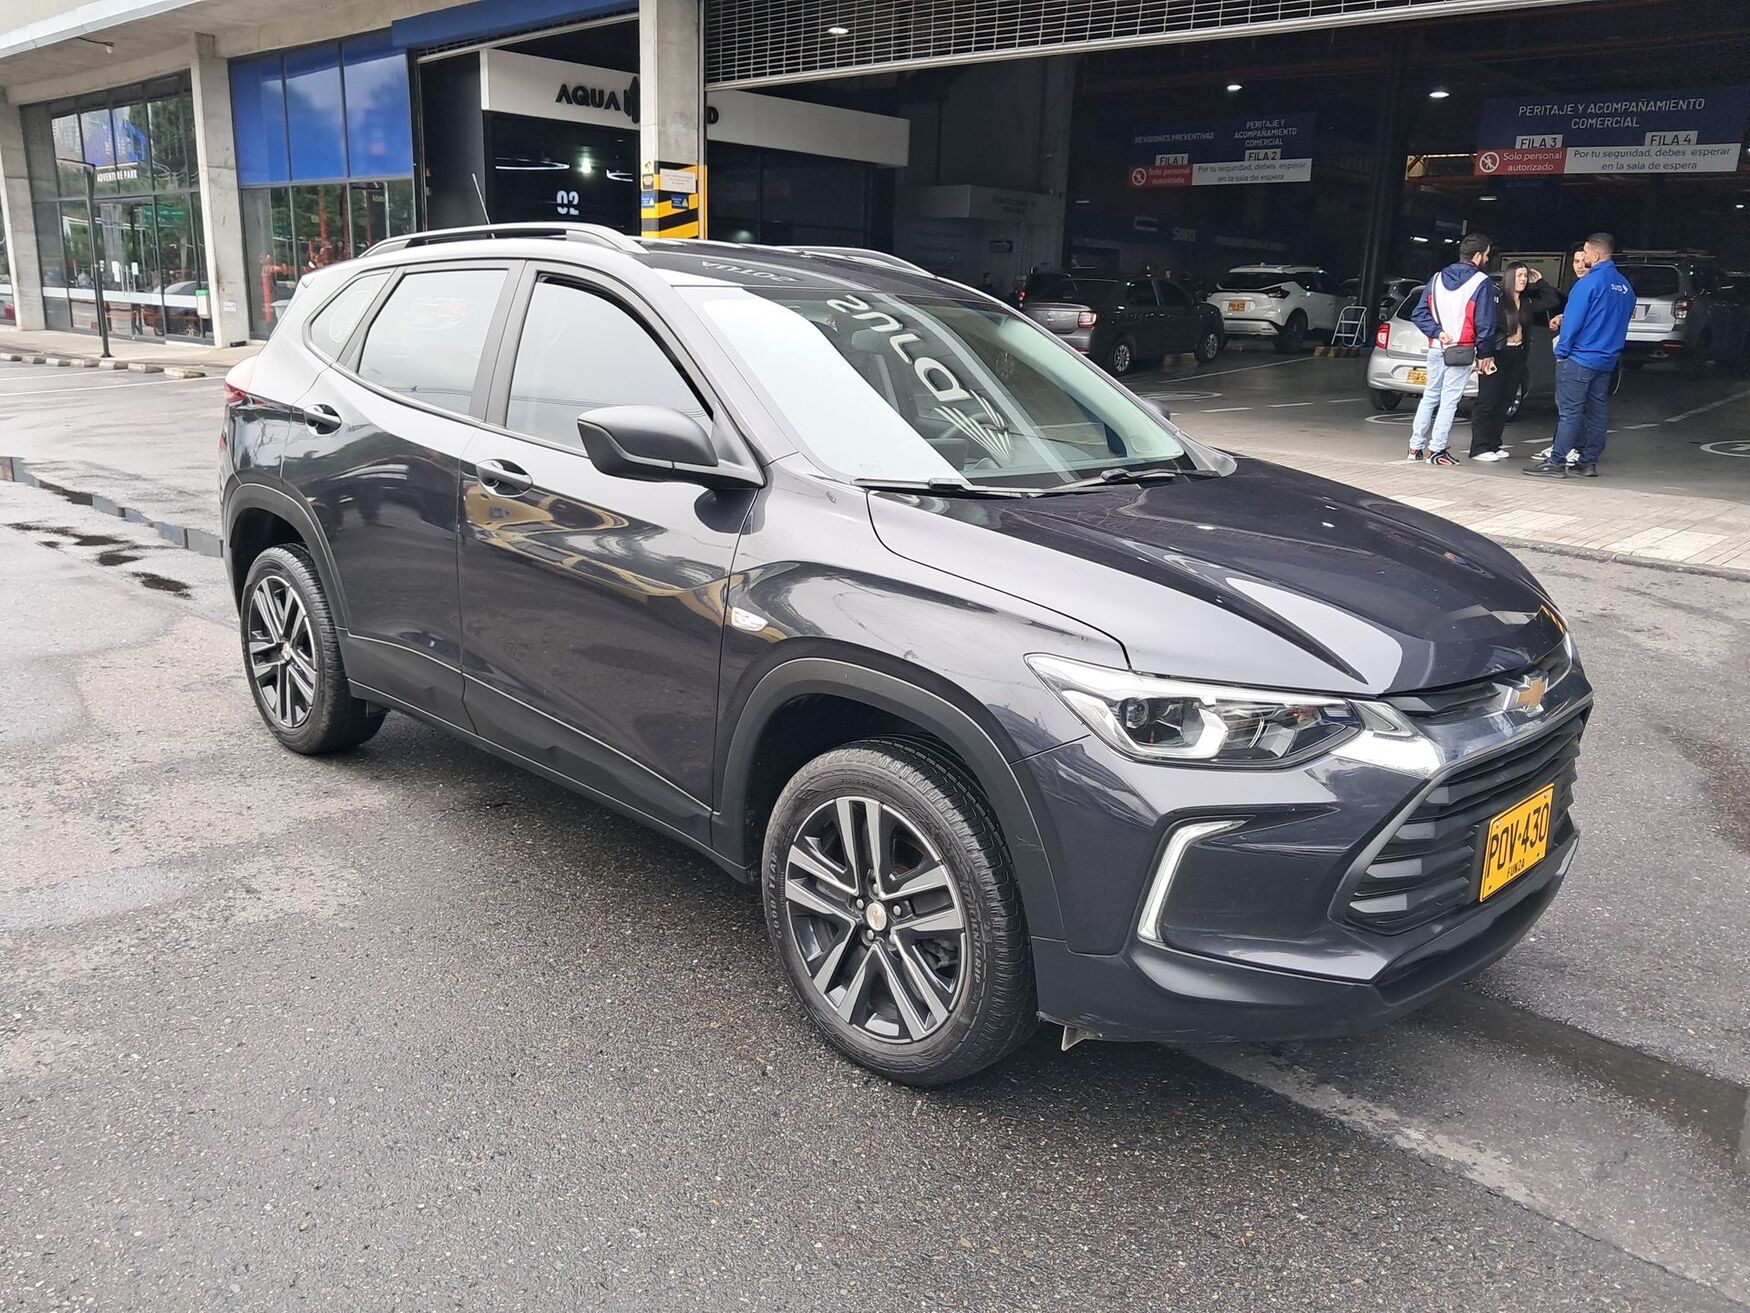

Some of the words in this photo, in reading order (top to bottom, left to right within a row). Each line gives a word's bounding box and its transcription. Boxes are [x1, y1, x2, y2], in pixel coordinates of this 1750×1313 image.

[556, 84, 621, 111] AQUA
[1519, 104, 1575, 116] PERITAJE
[1579, 104, 1585, 114] Y
[1588, 98, 1705, 114] ACOMPAÑAMIENTO
[1246, 120, 1279, 128] PERITAJE
[1572, 116, 1640, 128] COMERCIAL
[1234, 128, 1298, 139] ACOMPAÑAMIENTO
[1245, 139, 1284, 147] COMERCIAL
[1520, 138, 1546, 148] FILA
[1550, 138, 1558, 148] 3
[1650, 134, 1680, 146] FILA
[1684, 134, 1692, 145] 4
[1248, 152, 1270, 160] FILA
[1271, 152, 1277, 160] 2
[1504, 152, 1522, 160] Solo
[1523, 152, 1562, 162] personal
[1574, 150, 1588, 158] Por
[1591, 150, 1600, 158] tu
[1655, 148, 1686, 157] debes
[1691, 148, 1730, 157] esperar
[1160, 156, 1180, 166] FILA
[1602, 162, 1614, 170] en
[1616, 162, 1624, 170] la
[1626, 162, 1646, 170] sala
[1648, 161, 1661, 170] de
[1663, 162, 1697, 170] espera
[1508, 162, 1554, 172] autorizado
[124, 169, 138, 180] PARK
[556, 190, 579, 216] 02
